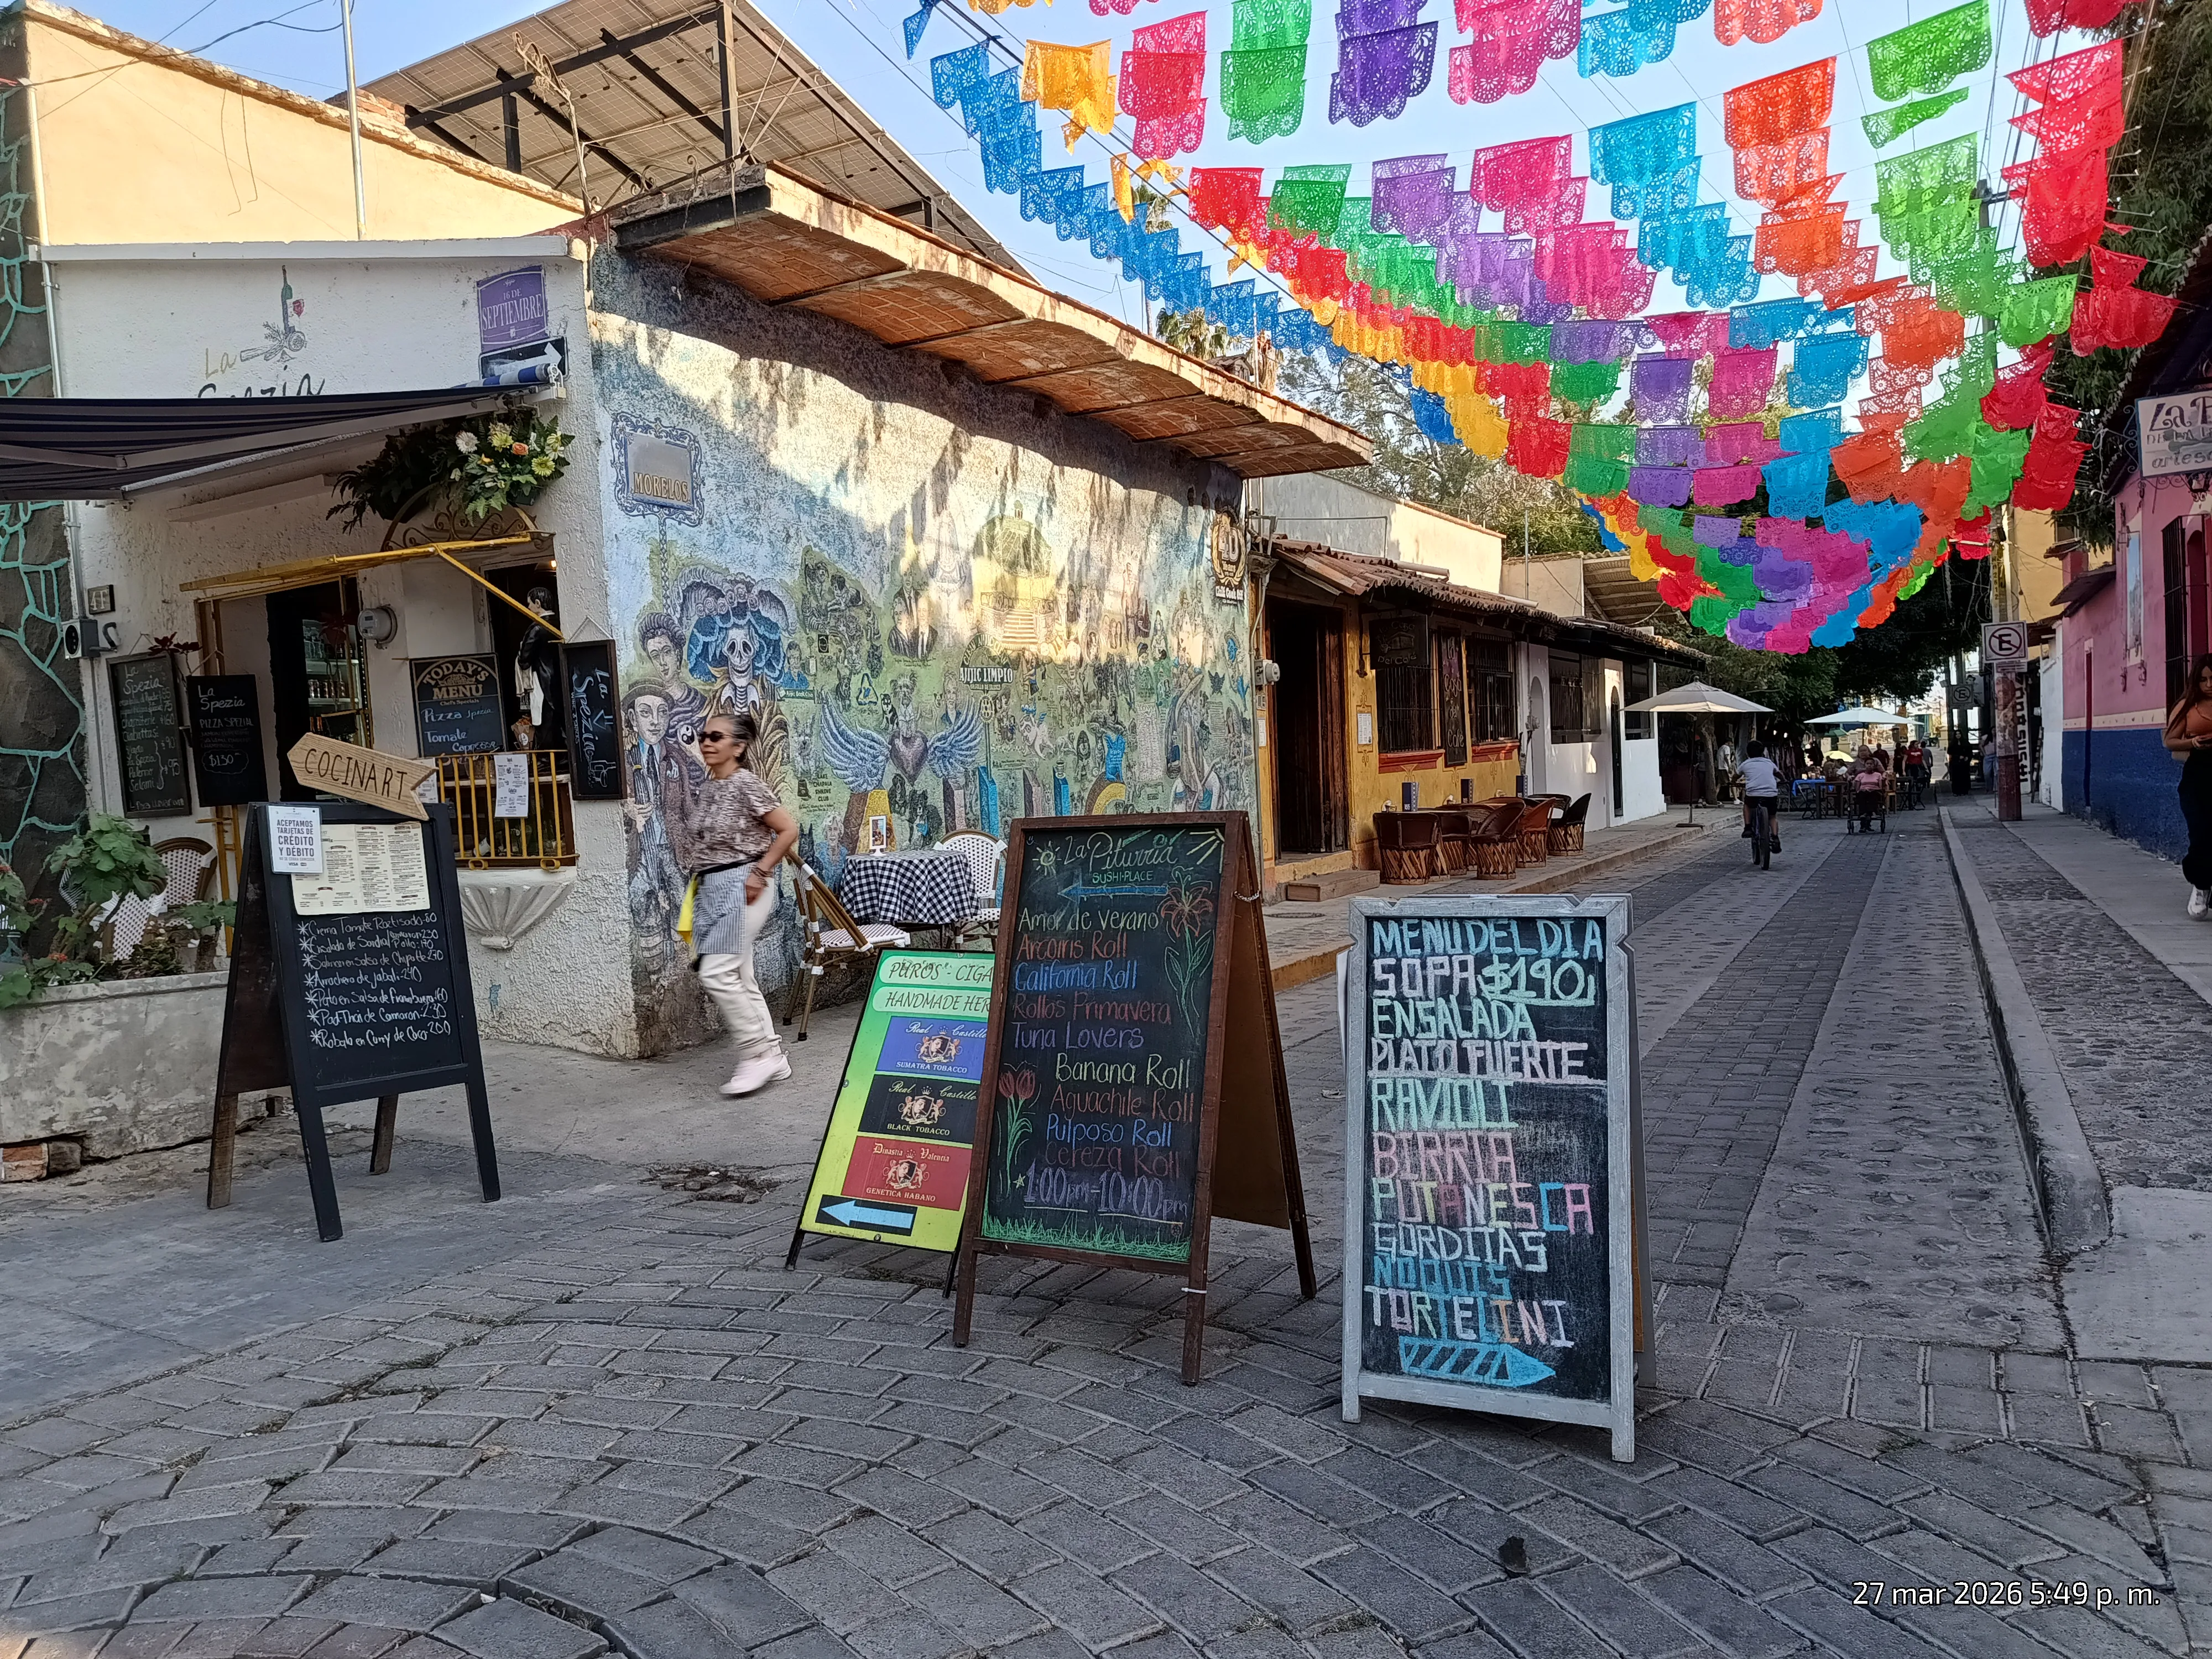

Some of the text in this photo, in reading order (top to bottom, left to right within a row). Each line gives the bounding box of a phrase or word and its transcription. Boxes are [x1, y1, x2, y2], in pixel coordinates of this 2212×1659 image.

[503, 288, 522, 300] 16 DE
[482, 293, 544, 331] SEPTIEMBRE
[205, 348, 237, 380] La
[2149, 403, 2192, 431] La
[633, 472, 688, 502] MORELOS
[963, 639, 977, 665] CLEAN
[1999, 633, 2012, 651] E
[124, 665, 139, 679] La
[422, 661, 489, 686] TODAY'S
[959, 667, 1013, 684] AJIJIC LIMPIO
[123, 675, 164, 697] Spezia
[198, 685, 216, 698] La
[432, 684, 484, 700] MENU
[594, 667, 610, 700] La
[1444, 674, 1462, 697] Casa
[1959, 689, 1966, 698] E
[200, 696, 246, 713] Spezia
[420, 708, 462, 723] Pizza
[200, 718, 223, 728] PIZZA
[572, 673, 599, 760] Spezia
[424, 728, 467, 743] Tomate
[1447, 729, 1464, 748] Café
[305, 748, 408, 800] COCINART
[278, 834, 314, 846] CRÉDITO
[1064, 836, 1088, 865] La
[279, 846, 314, 857] Y DÉBITO
[309, 916, 373, 936] Crema Tomate
[1018, 907, 1062, 932] Amor
[1066, 907, 1092, 932] de
[310, 936, 345, 955] Ensalada
[347, 937, 356, 950] de
[1016, 930, 1128, 961] Arcoiris Roll
[1373, 918, 1604, 962] MENU DEL DIA
[311, 955, 346, 970] Salmon
[345, 959, 354, 967] en
[380, 953, 390, 966] de
[888, 962, 941, 982] PUROS
[356, 969, 371, 984] de
[1014, 959, 1138, 992] California Roll
[1372, 954, 1478, 999] SOPA
[338, 995, 351, 1005] en
[351, 988, 380, 1004] Salsa
[379, 989, 390, 1004] de
[885, 992, 960, 1011] HANDMADE
[364, 1008, 377, 1022] de
[1011, 992, 1171, 1025] Rollos Primavera
[1372, 994, 1537, 1041] ENSALADA
[319, 1029, 353, 1048] Robalo
[355, 1038, 366, 1046] en
[366, 1029, 390, 1048] Curry
[393, 1026, 406, 1042] de
[905, 1021, 987, 1039] Real Castillo
[1011, 1020, 1145, 1050] Tuna Lovers
[896, 1061, 968, 1073] SUMATRA TOBACCO
[1371, 1037, 1589, 1082] PLATO FUERTE
[1055, 1052, 1191, 1090] Banana Roll
[888, 1080, 977, 1101] Real Castillo
[1050, 1083, 1194, 1123] Aguachile Roll
[1371, 1077, 1519, 1132] RAVIOLI
[887, 1123, 950, 1136] BLACK TOBACCO
[1046, 1113, 1172, 1150] Pulposo Roll
[872, 1142, 950, 1163] Dinastia Valencia
[1045, 1141, 1181, 1180] Cereza Roll
[1372, 1130, 1519, 1183] BIRRIA
[866, 1187, 936, 1202] GENETICA HABANO
[1373, 1177, 1594, 1235] PUTANESCA
[1370, 1221, 1548, 1274] GORDITAS
[1364, 1286, 1575, 1348] TORTELINI
